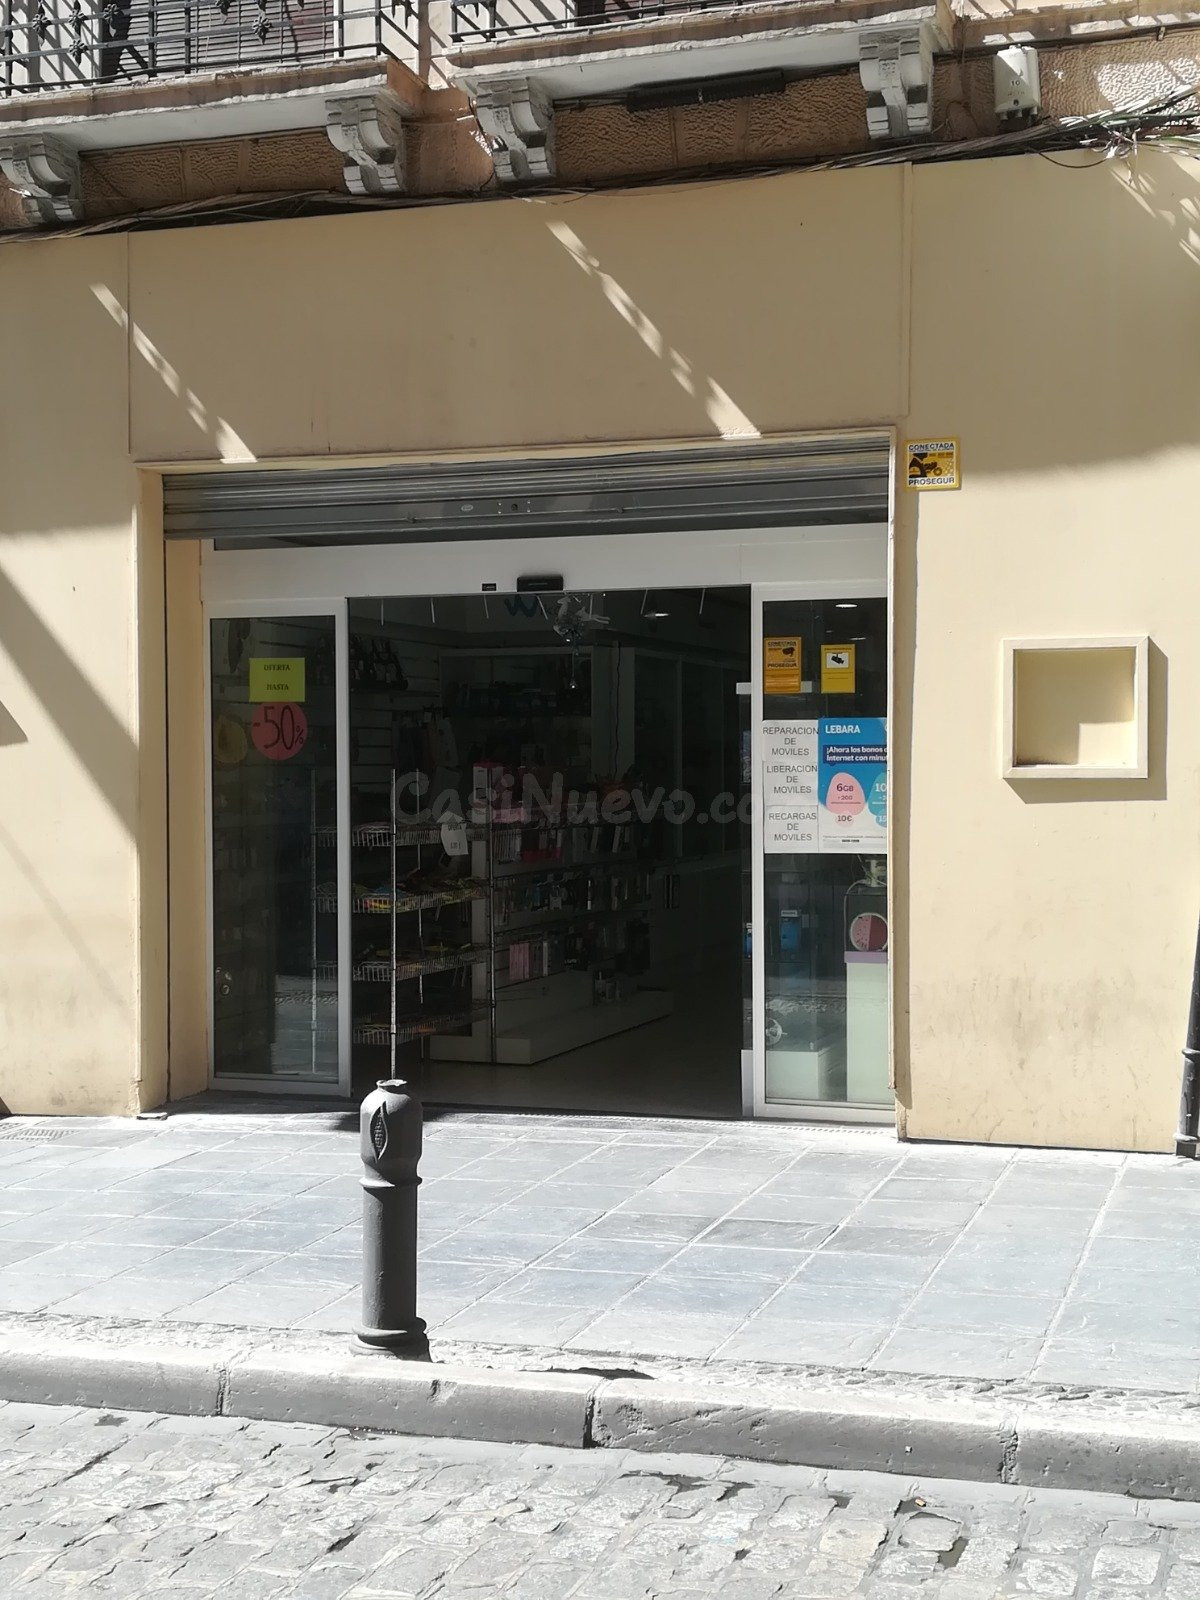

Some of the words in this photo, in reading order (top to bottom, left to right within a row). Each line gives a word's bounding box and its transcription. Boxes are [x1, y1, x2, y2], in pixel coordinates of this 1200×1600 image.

[908, 442, 954, 451] CONECTADA
[908, 477, 954, 486] PROSEGUR
[762, 726, 819, 735] REPARACION
[825, 724, 861, 734] LEBARA
[784, 737, 797, 746] DE
[771, 747, 810, 756] MOVILES
[826, 754, 854, 762] Internet
[766, 765, 818, 773] LIBERACION
[786, 775, 799, 783] DE
[773, 785, 812, 794] MOVILES
[836, 783, 854, 792] 6GB
[768, 812, 817, 820] RECARGAS
[786, 822, 800, 831] DE
[774, 833, 813, 841] MOVILES
